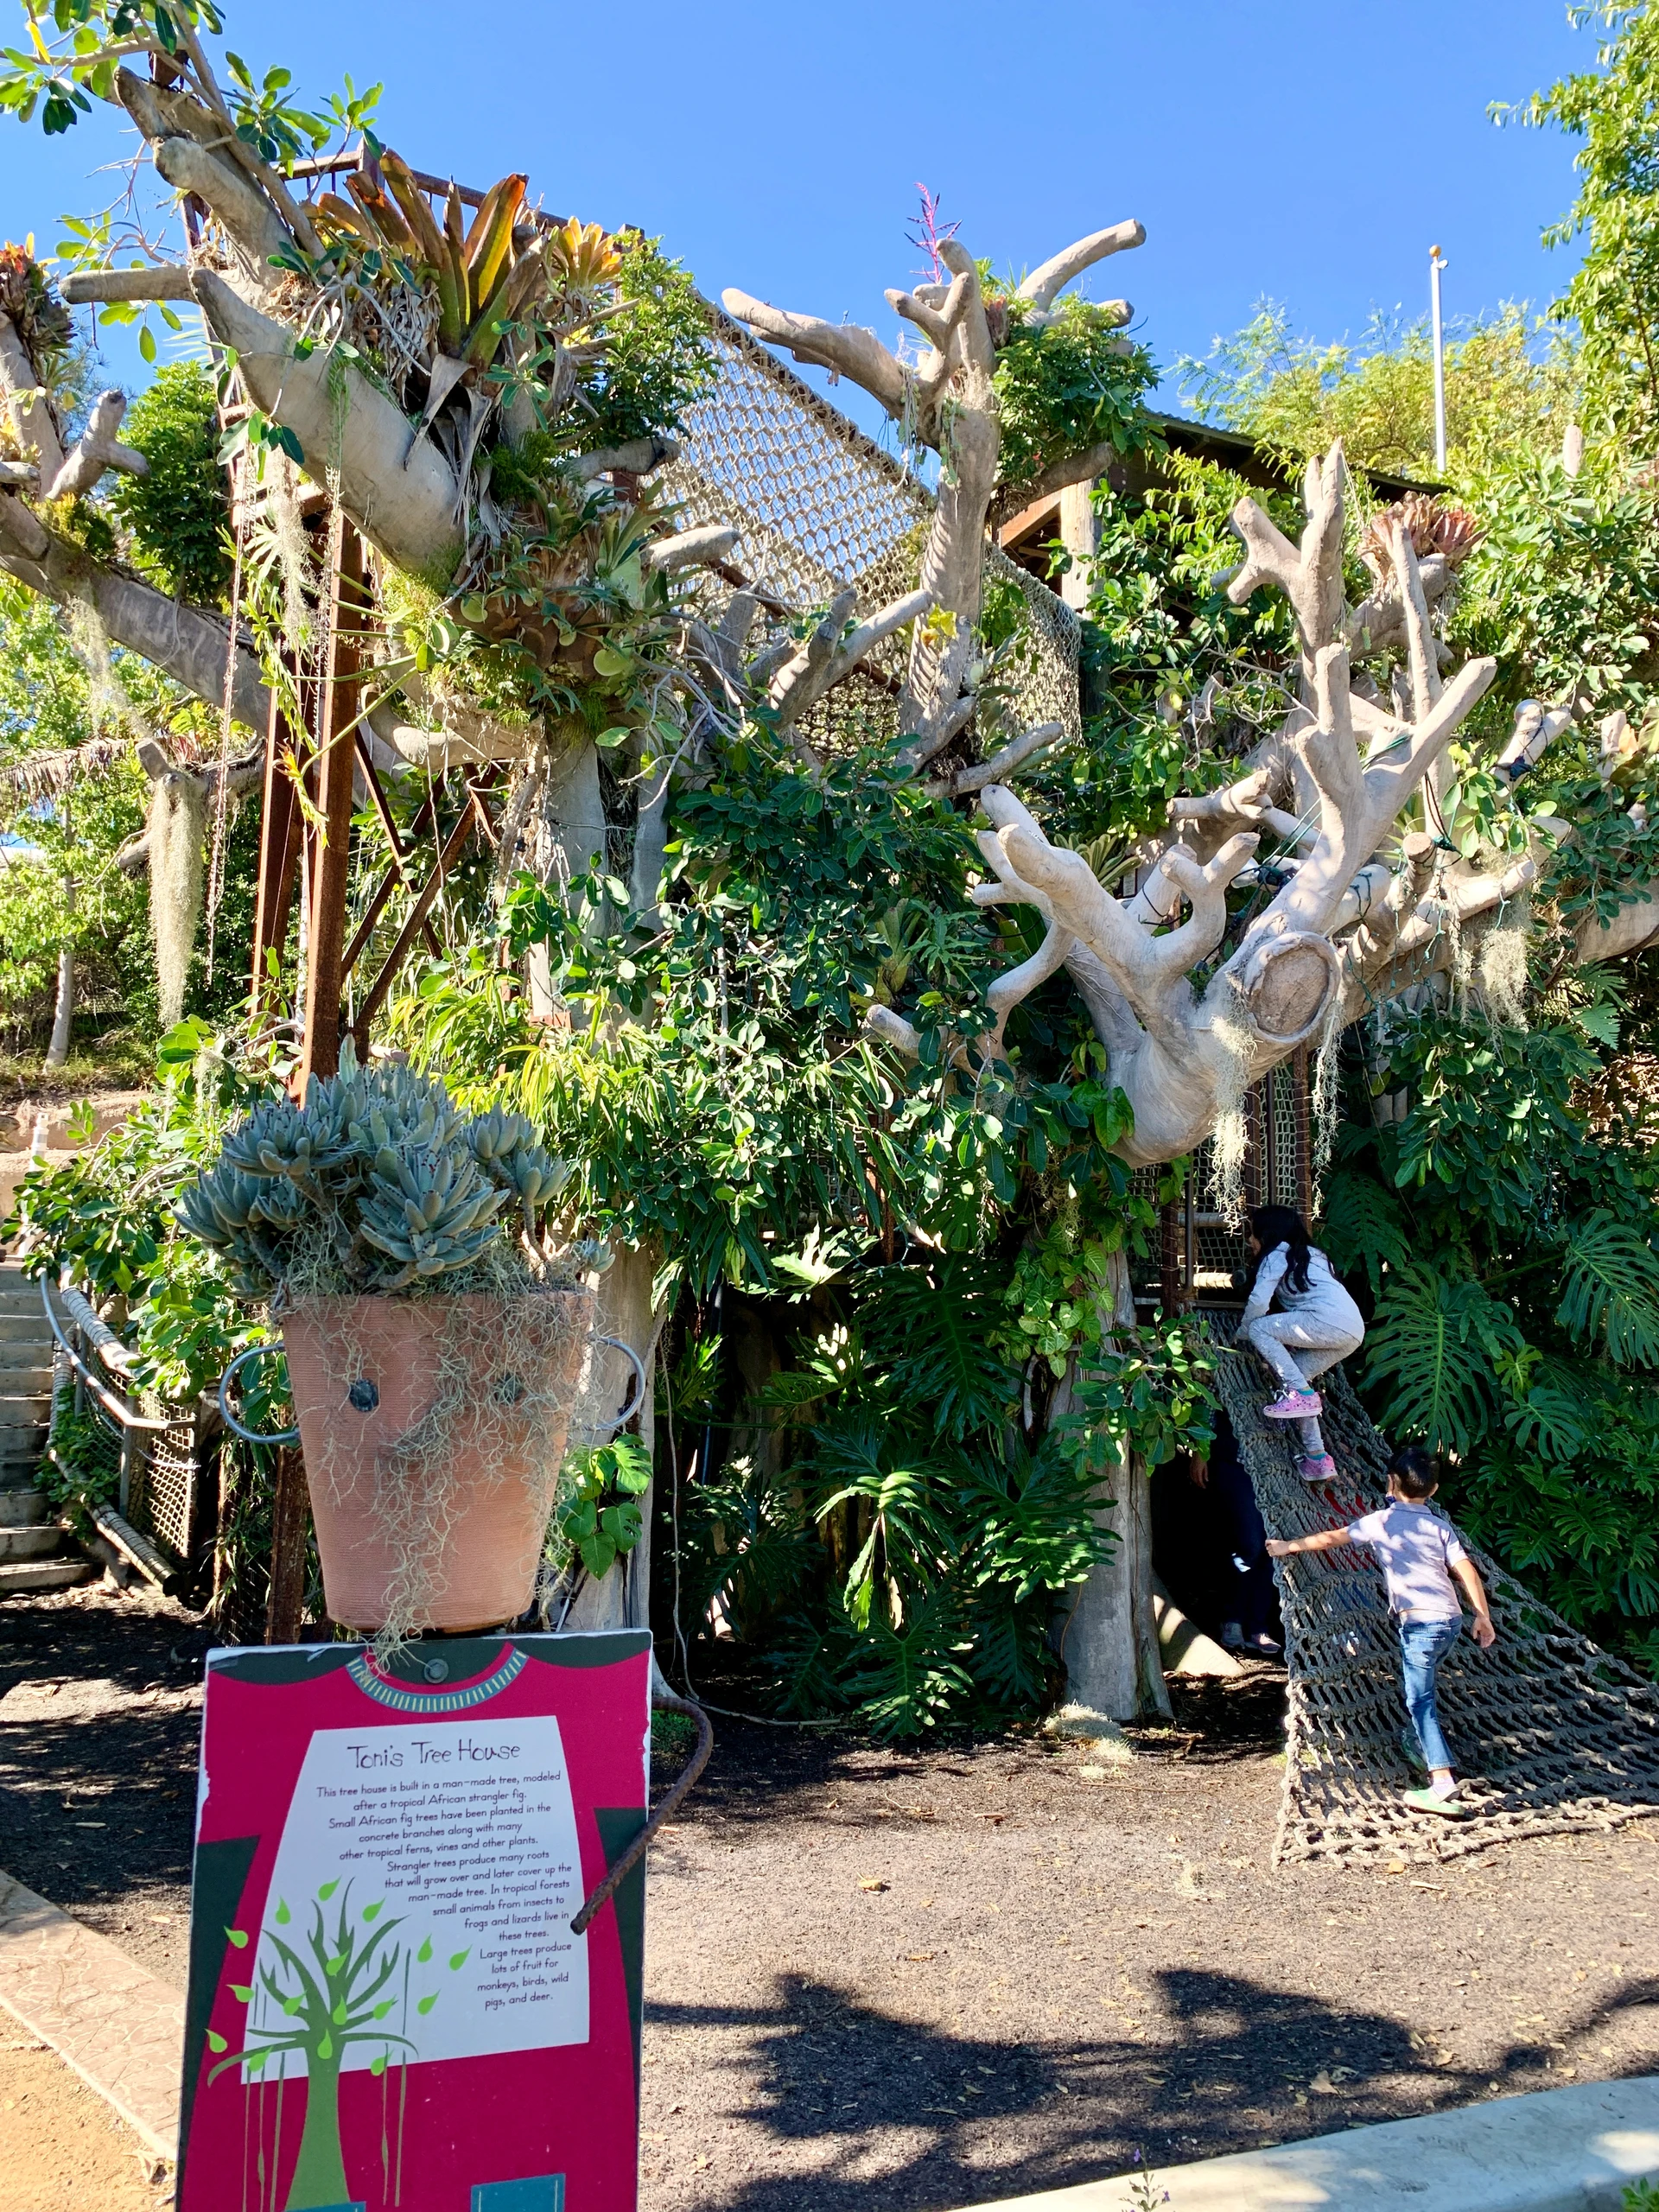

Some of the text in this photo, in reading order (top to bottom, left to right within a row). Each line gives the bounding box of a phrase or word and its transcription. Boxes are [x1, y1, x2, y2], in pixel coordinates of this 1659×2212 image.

[346, 1738, 520, 1769] Toni's Tree House
[316, 1787, 336, 1797] This
[361, 1783, 387, 1794] house
[400, 1780, 419, 1791] built
[499, 1776, 519, 1785] tree,
[523, 1770, 561, 1783] modeled
[353, 1799, 378, 1811] after
[390, 1795, 425, 1811] tropical
[428, 1794, 466, 1805] African
[468, 1789, 510, 1805] strangler
[512, 1788, 527, 1803] fig.
[328, 1816, 356, 1829] Small
[358, 1815, 397, 1827] African
[400, 1812, 412, 1827] fig
[441, 1809, 463, 1820] have
[466, 1808, 487, 1818] been
[490, 1803, 524, 1820] planted
[537, 1802, 551, 1812] the
[359, 1821, 523, 1842] concrete branches along with many
[340, 1835, 538, 1861] other tropical ferns, vines and other plants.
[387, 1851, 550, 1874] Strangler trees produce many roots
[385, 1878, 404, 1888] that
[406, 1875, 421, 1886] will
[423, 1877, 448, 1890] grow
[473, 1868, 491, 1880] and
[493, 1868, 515, 1878] later
[545, 1867, 556, 1878] up
[558, 1862, 572, 1872] the
[466, 1888, 486, 1897] tree.
[491, 1884, 499, 1895] In
[503, 1880, 537, 1897] tropical
[539, 1879, 570, 1890] forests
[433, 1903, 457, 1916] small
[460, 1900, 495, 1913] animals
[498, 1898, 521, 1910] from
[524, 1897, 553, 1907] insects
[464, 1917, 488, 1932] frogs
[491, 1914, 509, 1926] and
[512, 1911, 542, 1923] lizards
[544, 1910, 558, 1921] live
[499, 1930, 522, 1941] these
[480, 1948, 508, 1962] Large
[536, 1941, 572, 1957] produce
[492, 1957, 559, 1974] lots of fruit for
[477, 1971, 569, 1993] monkeys, birds, wild
[485, 1991, 553, 2011] pigs, and deer.
